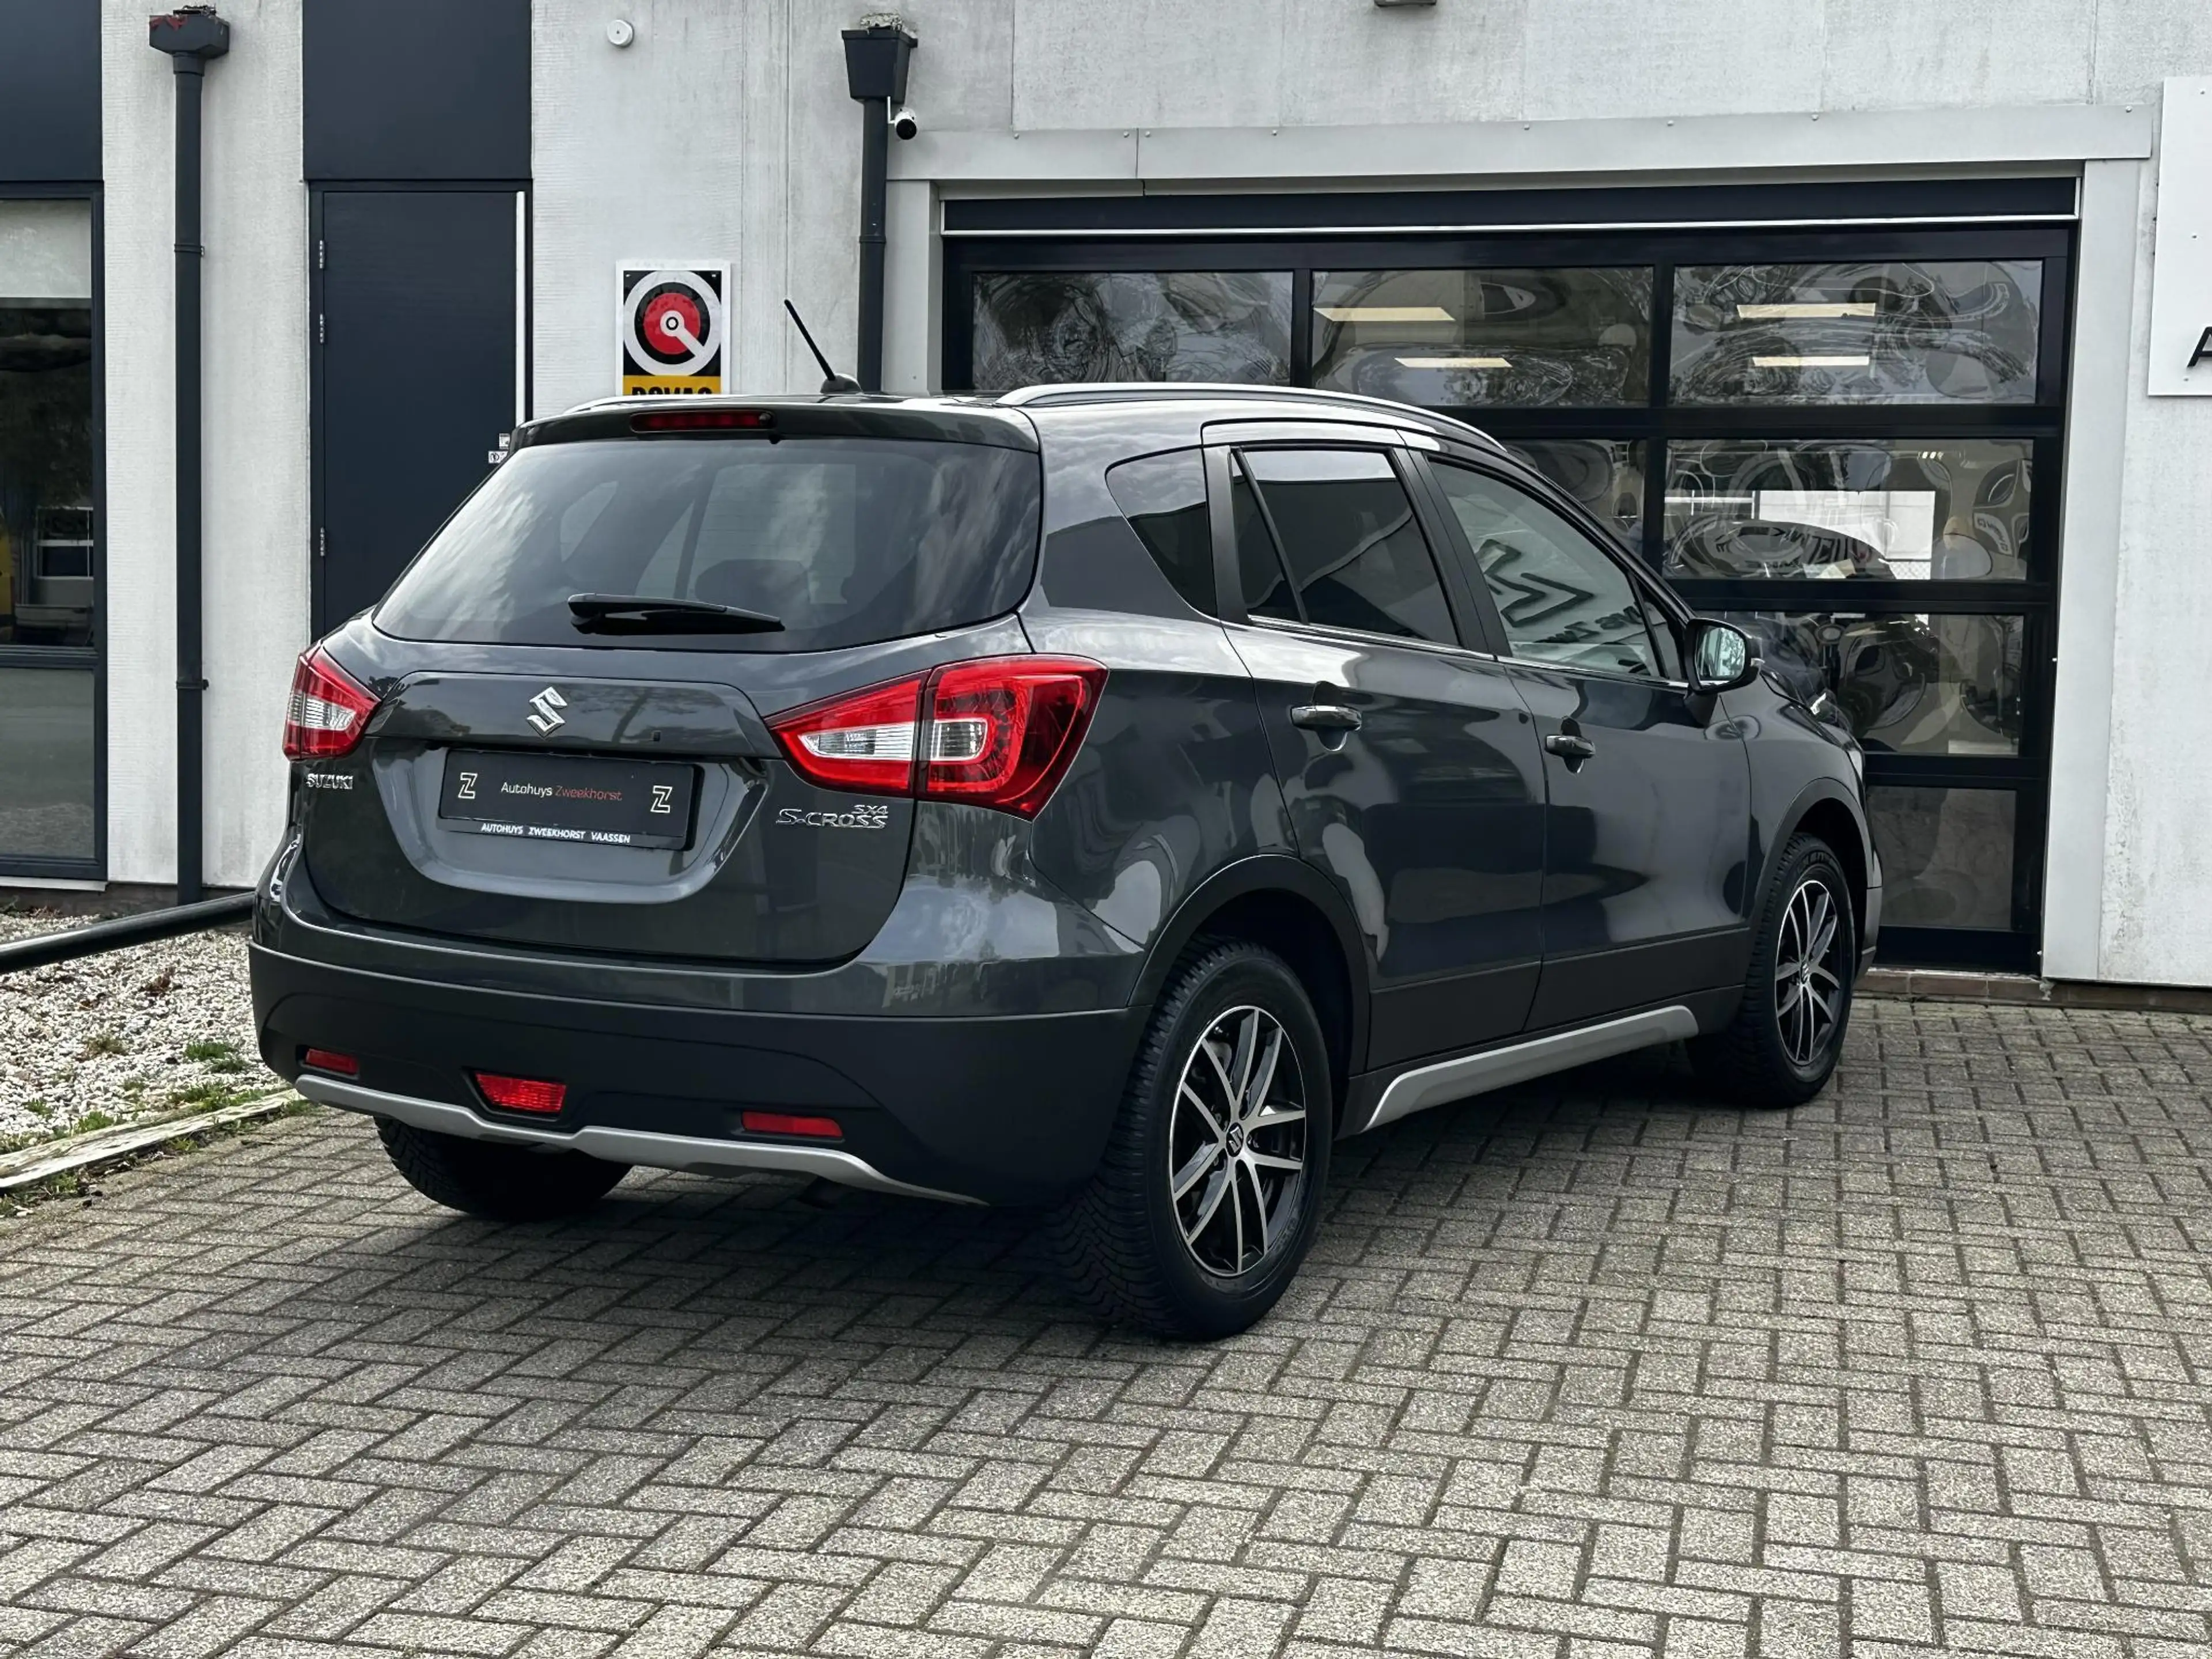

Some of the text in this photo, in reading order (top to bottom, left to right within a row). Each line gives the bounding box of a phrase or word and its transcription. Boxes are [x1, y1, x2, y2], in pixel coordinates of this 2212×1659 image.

[306, 773, 354, 790] SUZUKI
[501, 782, 623, 801] Autohuys Zweekhorst
[851, 804, 889, 815] SX4
[480, 822, 631, 844] AUTOHUYS ZWEEKHORST VAASSEN
